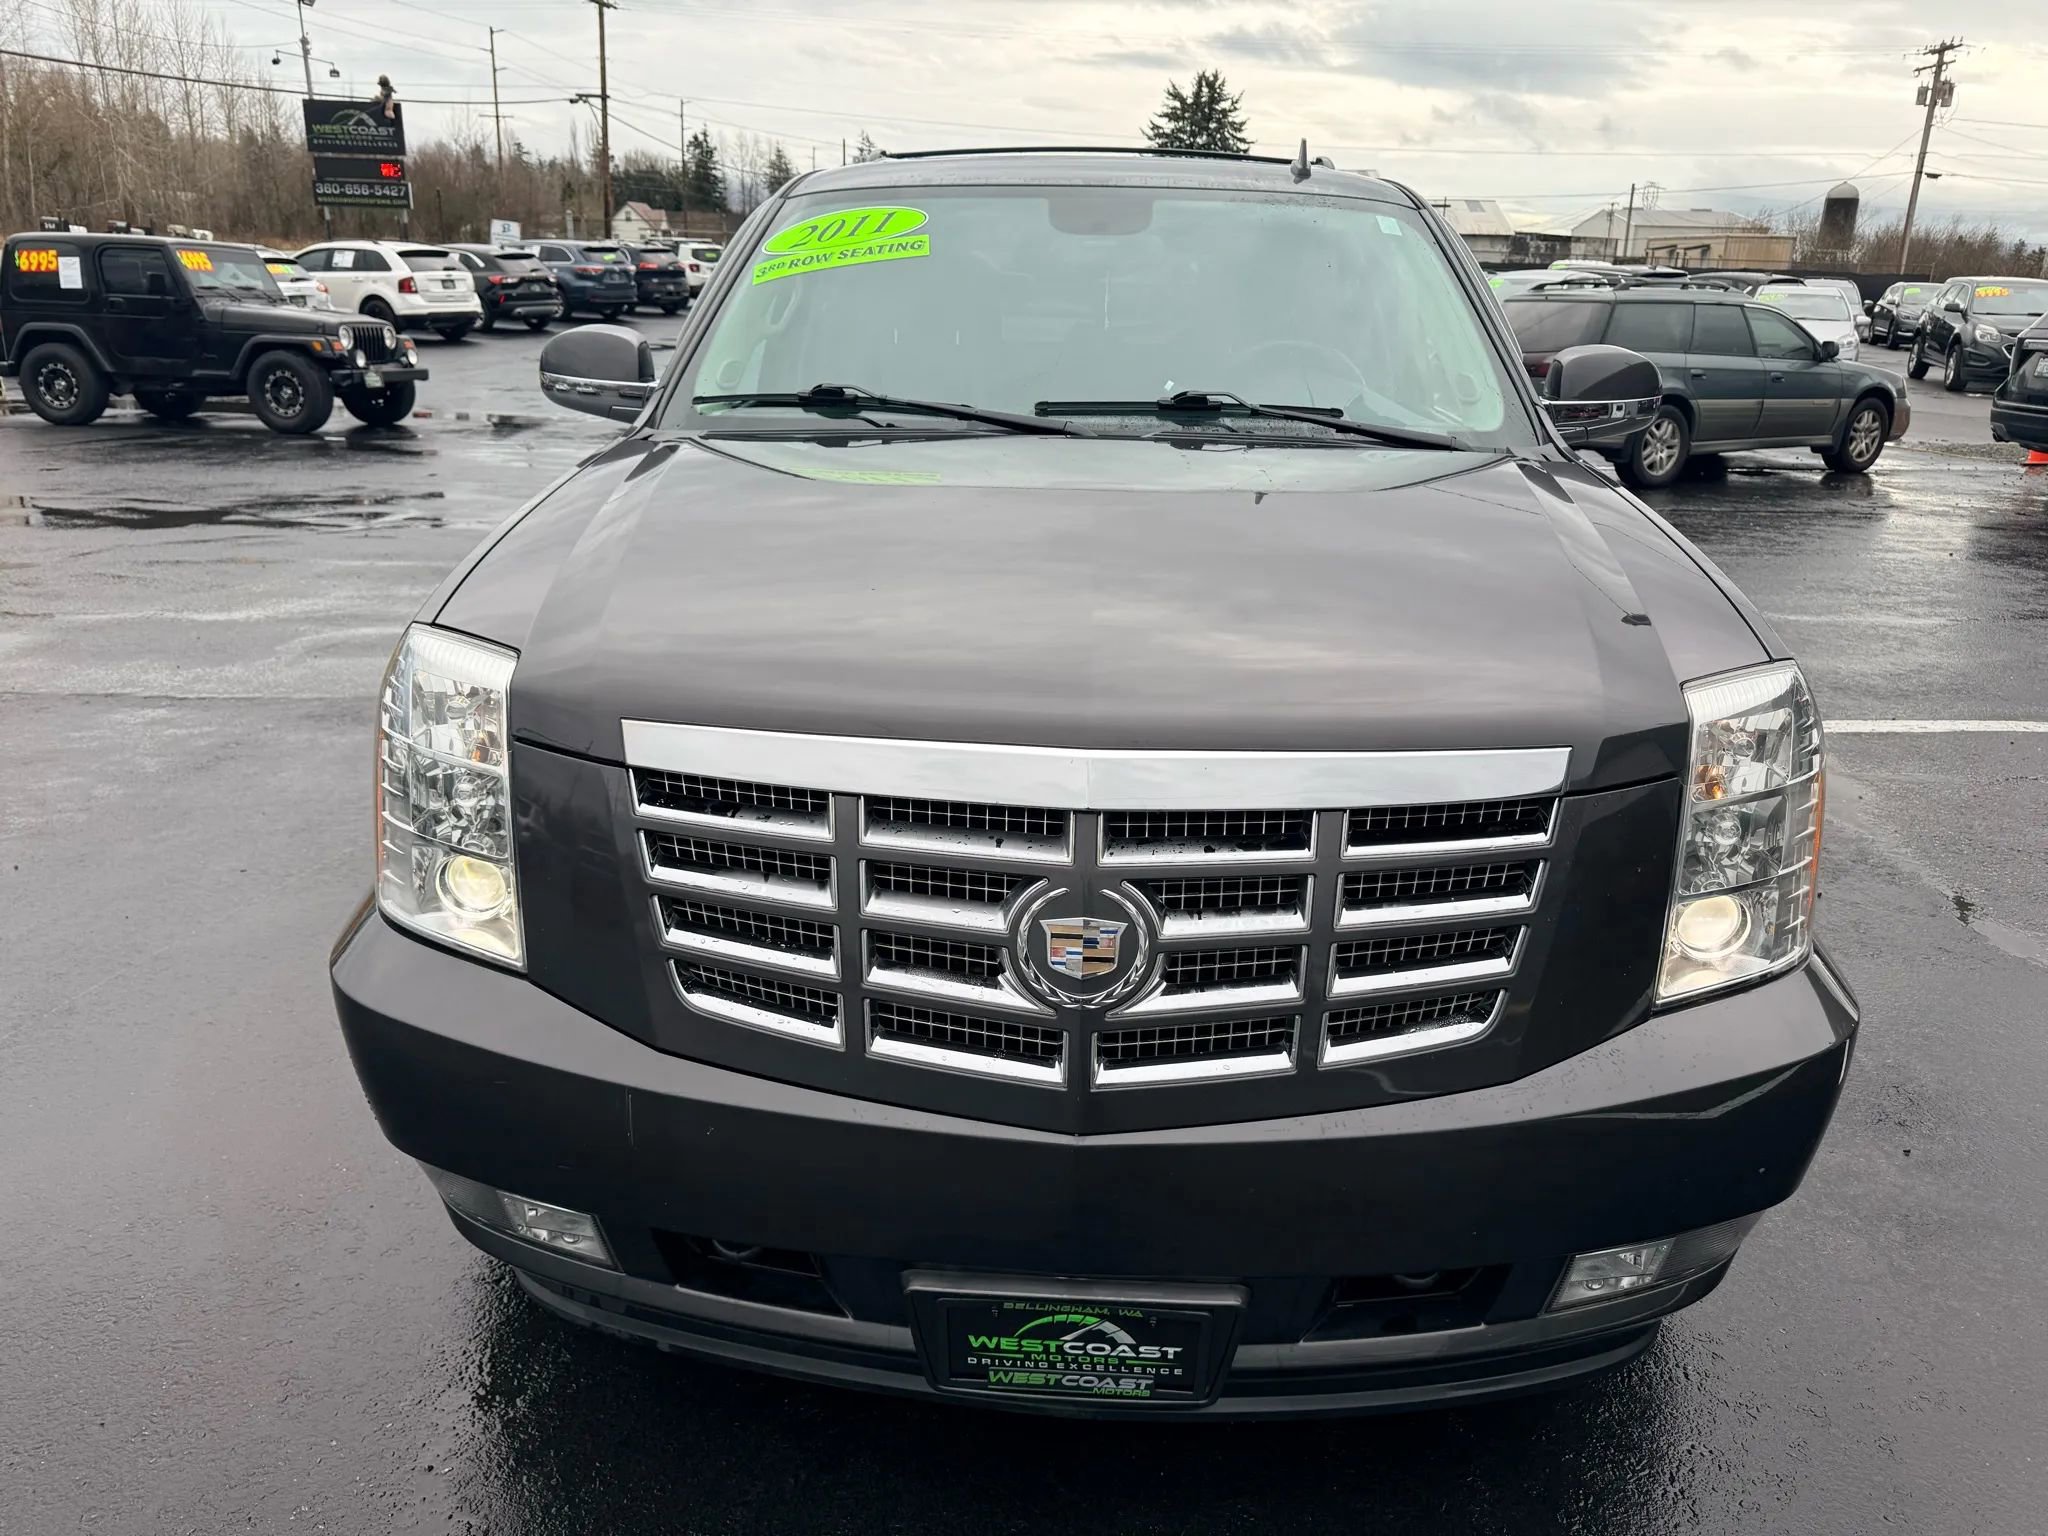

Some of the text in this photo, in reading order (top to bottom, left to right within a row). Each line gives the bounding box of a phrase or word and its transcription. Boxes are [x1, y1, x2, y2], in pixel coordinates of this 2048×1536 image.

[312, 124, 396, 136] WESTCOAST
[315, 182, 407, 197] 360-656-5427
[788, 211, 897, 250] 2011
[756, 240, 926, 278] 3RD ROW SEATING
[1118, 1309, 1144, 1318] WA
[967, 1334, 1183, 1360] WESTCOAST
[967, 1356, 1183, 1375] DRIVING EXCELLENCE
[1031, 1353, 1119, 1365] MOTORS
[988, 1370, 1154, 1390] WESTCOAST
[1092, 1386, 1151, 1397] MOTORS
